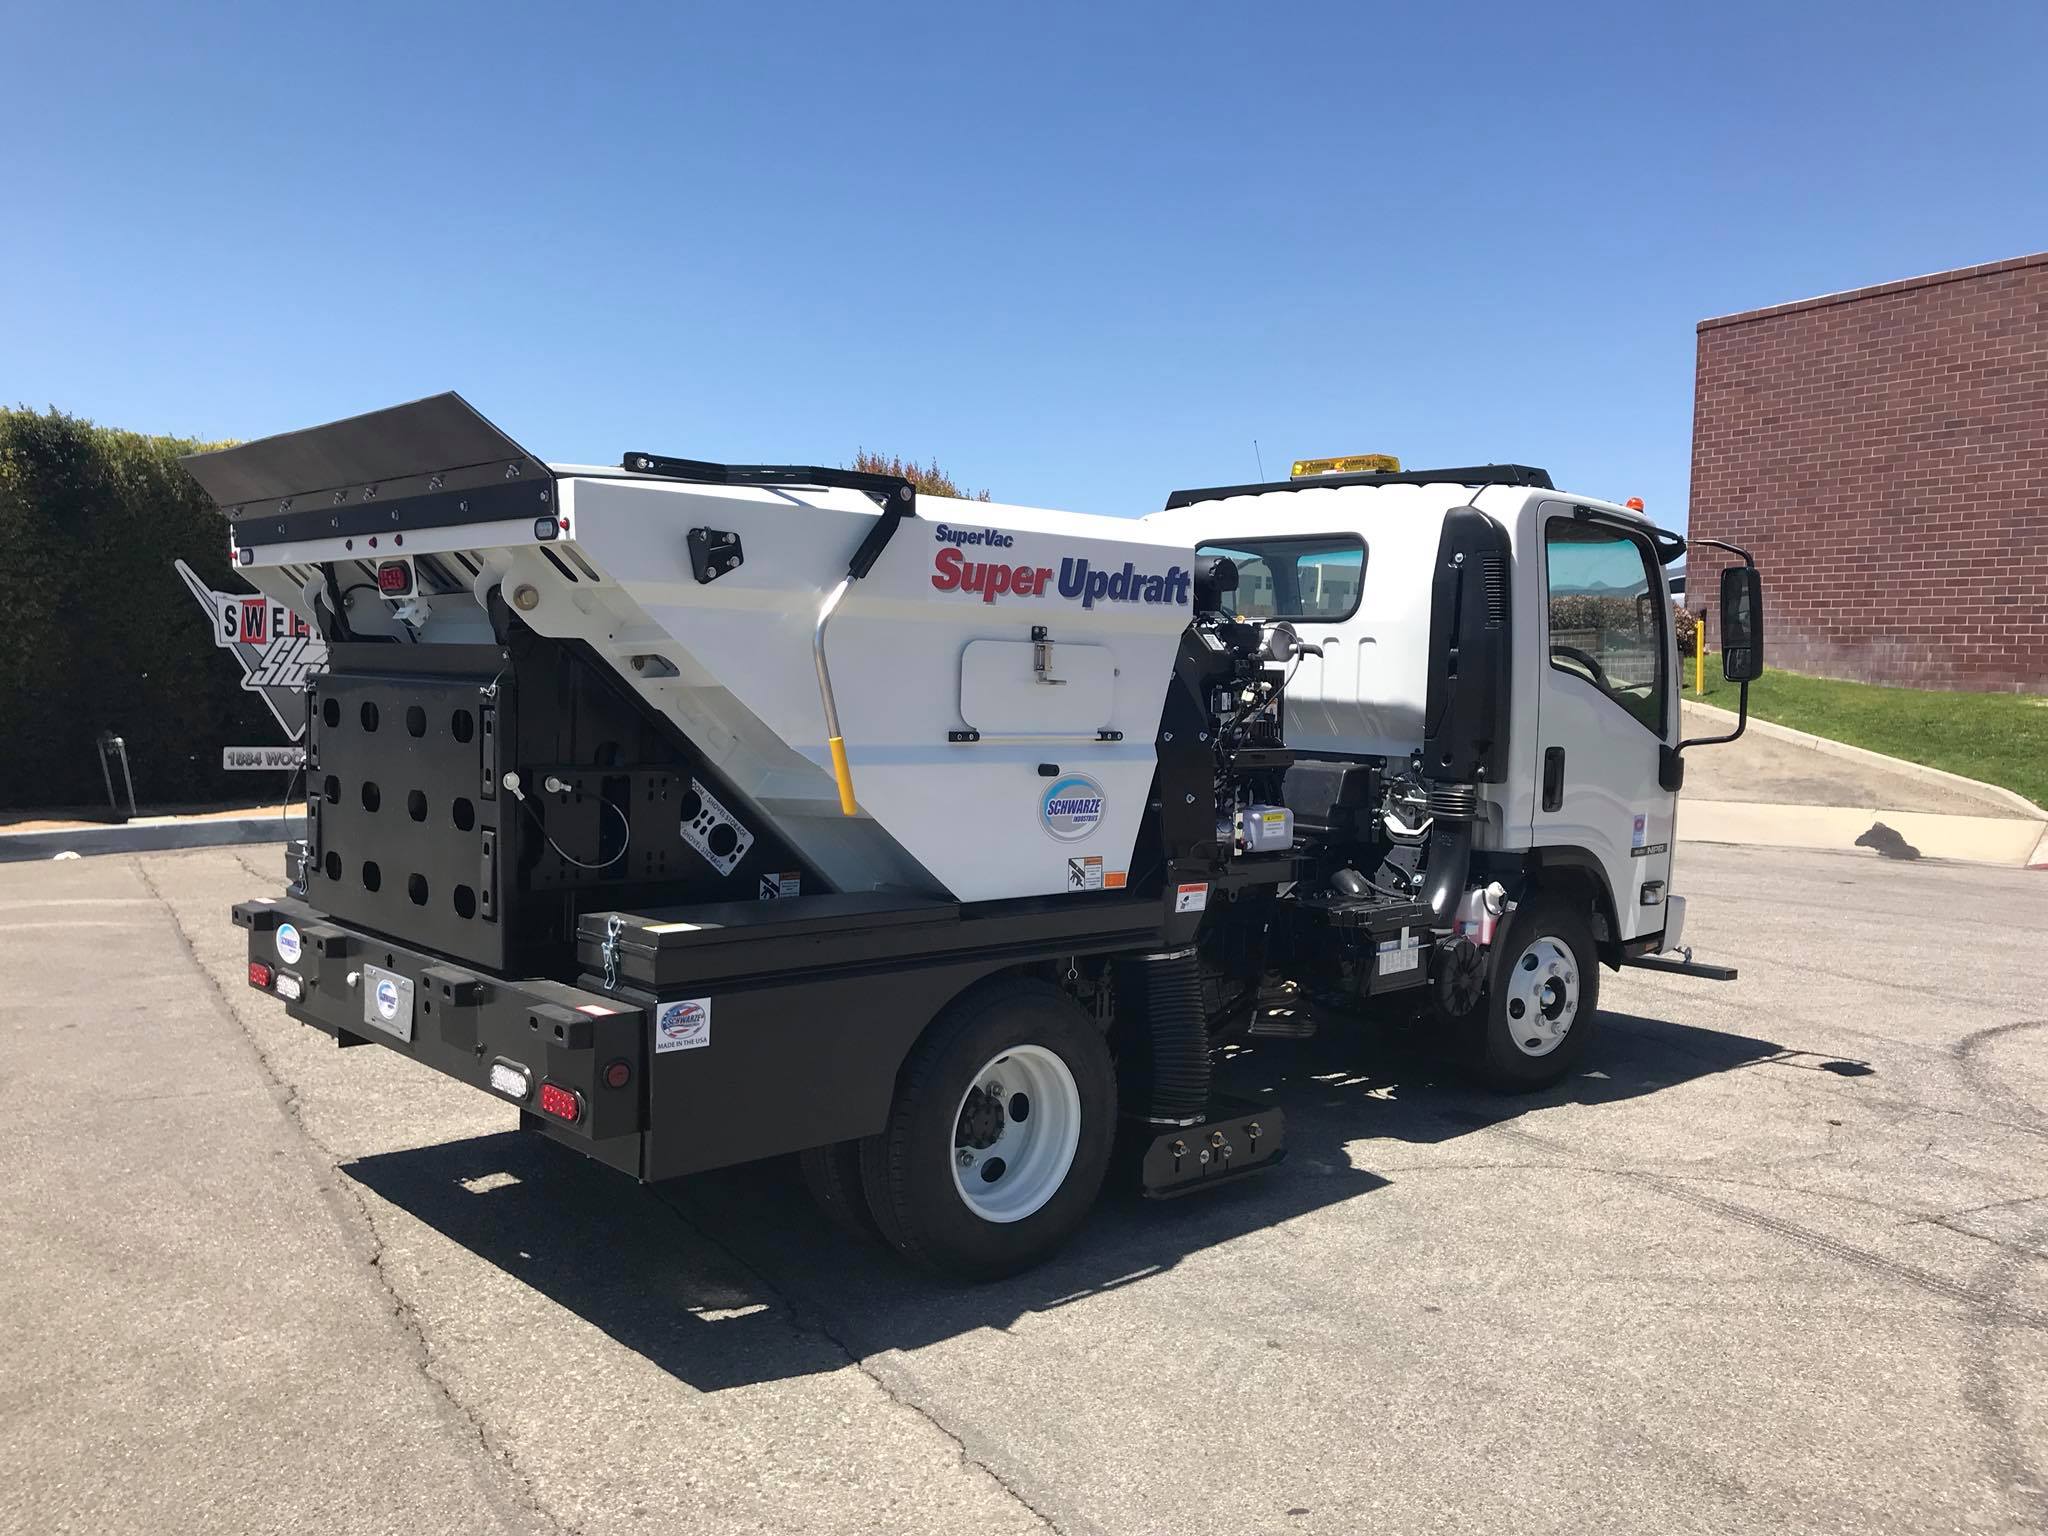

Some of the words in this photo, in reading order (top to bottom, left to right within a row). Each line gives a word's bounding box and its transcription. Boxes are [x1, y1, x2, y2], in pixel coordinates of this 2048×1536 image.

[935, 524, 1014, 548] SuperVac
[932, 547, 1053, 605] Super
[1058, 557, 1192, 609] Updraft
[1048, 799, 1102, 815] SCHWARZE
[725, 814, 748, 838] STORAGE
